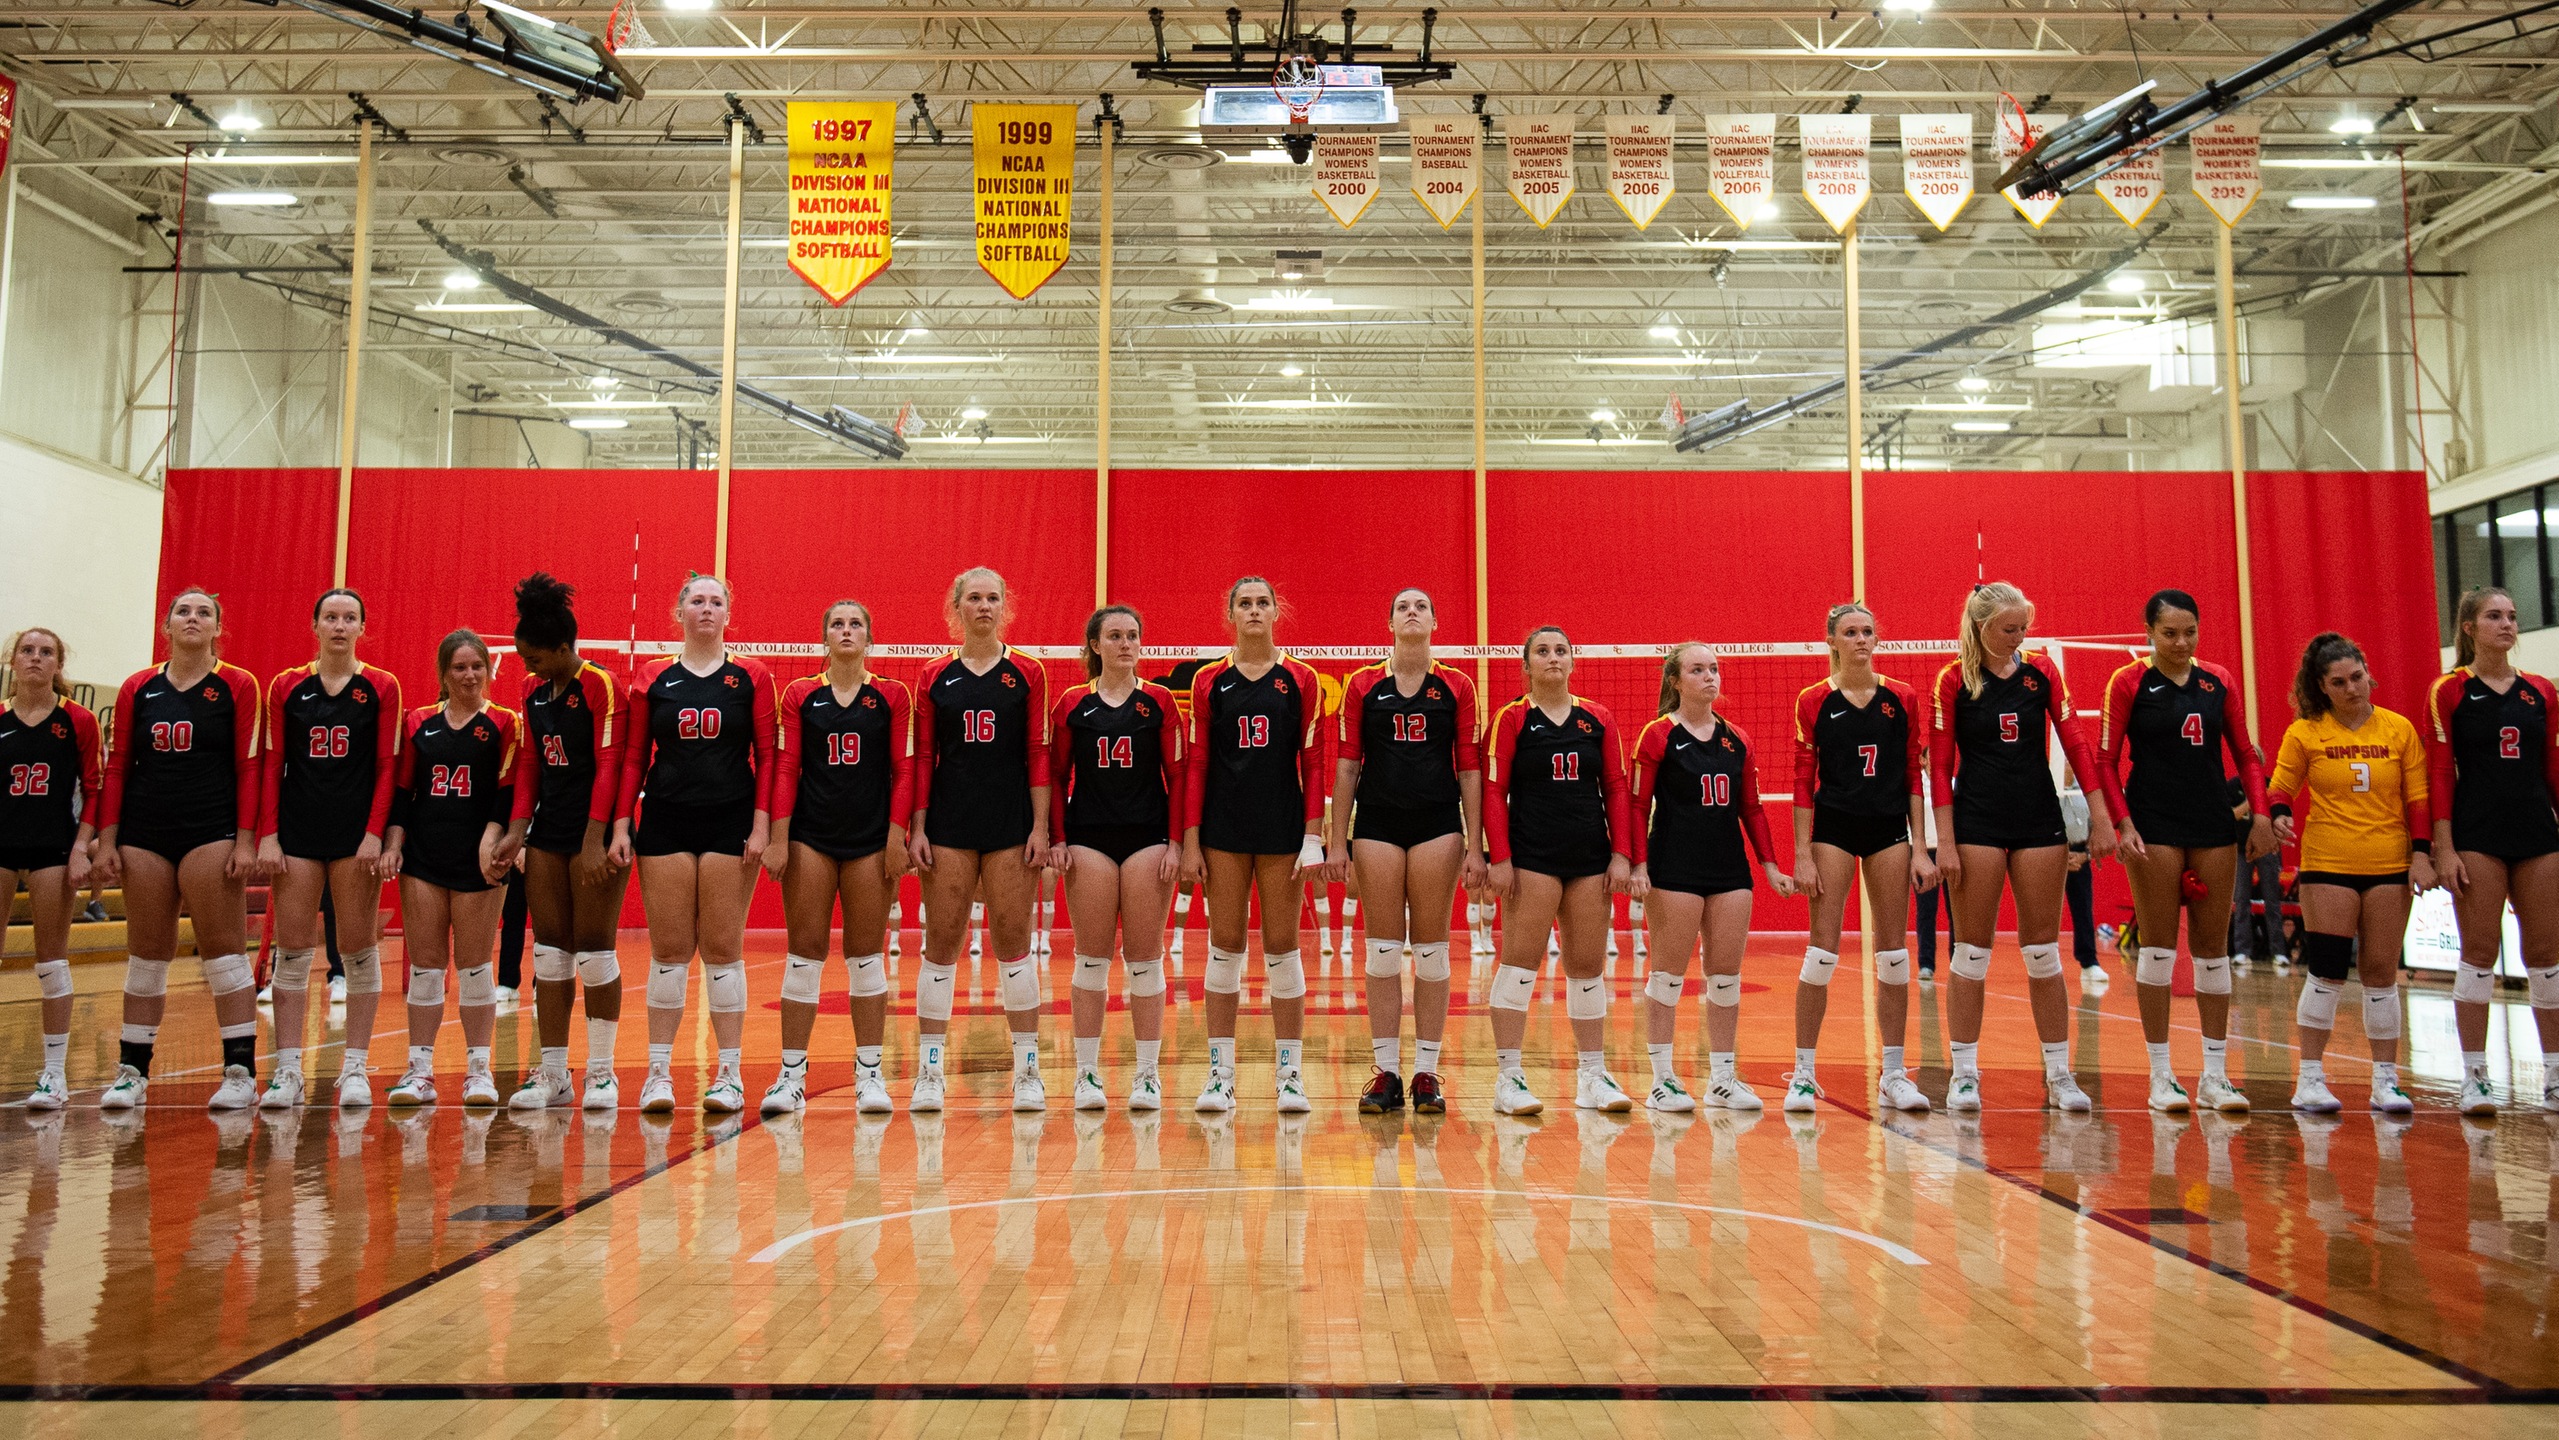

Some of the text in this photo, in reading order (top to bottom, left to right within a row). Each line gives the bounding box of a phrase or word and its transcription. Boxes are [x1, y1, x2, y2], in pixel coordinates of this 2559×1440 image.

[811, 119, 873, 142] 1997
[998, 121, 1053, 145] 1999
[1315, 135, 1378, 146] TOURNAMENT
[1412, 135, 1476, 146] TOURNAMENT
[1508, 135, 1572, 146] TOURNAMENT
[1609, 136, 1672, 146] TOURNAMENT
[1708, 135, 1773, 145] TOURNAMENT
[1905, 136, 1970, 146] TOURNAMENT
[2192, 136, 2260, 146] TOURNAMENT
[1318, 147, 1375, 157] CHAMPIONS
[1417, 147, 1472, 158] CHAMPIONS
[1512, 147, 1569, 157] CHAMPIONS
[1613, 148, 1668, 157] CHAMPIONS
[1713, 147, 1770, 157] CHAMPIONS
[1808, 148, 1864, 157] CHAMPIONS
[1909, 148, 1967, 158] CHAMPIONS
[2196, 148, 2257, 157] CHAMPIONS
[813, 152, 867, 169] NCAA
[1002, 156, 1045, 172] NCAA
[1325, 159, 1369, 169] WOMEN'S
[1421, 159, 1469, 170] BASEBALL
[1519, 158, 1563, 168] WOMEN'S
[1619, 159, 1662, 169] WOMEN'S
[1719, 158, 1764, 168] WOMEN'S
[1814, 159, 1858, 169] WOMEN'S
[1916, 159, 1961, 169] WOMEN'S
[2106, 160, 2154, 169] WMEN'S
[2203, 160, 2250, 168] WOMEN'S
[1317, 170, 1377, 181] BASKETBALL
[1512, 170, 1571, 180] BASKETBALL
[1612, 170, 1670, 181] BASKETBALL
[1713, 169, 1771, 180] VOLLEYBALL
[1806, 171, 1866, 180] BASKETBALL
[1909, 171, 1970, 181] BASKETBALL
[2195, 171, 2258, 181] BASKETBALL
[792, 173, 889, 191] DIVISION III
[977, 177, 1069, 194] DIVISION III
[1328, 183, 1367, 195] 2000
[1426, 182, 1464, 195] 2004
[1523, 182, 1560, 195] 2005
[1623, 183, 1660, 196] 2006
[1723, 182, 1762, 195] 2006
[1818, 183, 1857, 195] 2008
[1921, 183, 1959, 196] 2009
[2114, 185, 2149, 198] 2010
[798, 197, 882, 214] NATIONAL
[983, 200, 1062, 217] NATIONAL
[790, 219, 889, 236] CHAMPIONS
[975, 222, 1069, 239] CHAMPIONS
[796, 242, 882, 259] SOFTBALL
[983, 245, 1061, 262] SOFTBALL
[756, 643, 815, 654] COLLEGE
[887, 645, 945, 656] SIMPSON
[1138, 646, 1199, 657] COLLEGE
[1280, 646, 1390, 657] MPSON COLLEGE
[1463, 645, 1520, 656] SIMPSON
[1715, 643, 1775, 654] COLLEGE
[678, 707, 722, 740] 20
[963, 709, 996, 743] 16
[1393, 713, 1427, 742] 12
[1999, 712, 2019, 743] 5
[2181, 712, 2204, 746] 4
[151, 721, 194, 752] 30
[1238, 715, 1270, 748] 13
[309, 725, 350, 758] 26
[2499, 726, 2521, 759] 2
[543, 734, 570, 766] 21
[827, 732, 861, 766] 19
[1097, 736, 1133, 768] 14
[2325, 744, 2391, 761] SIMPSON
[1552, 752, 1579, 781] 11
[1858, 744, 1878, 777] 7
[9, 762, 51, 796] 32
[430, 764, 472, 797] 24
[2349, 761, 2372, 793] 3
[1700, 773, 1730, 806] 10
[2439, 931, 2460, 951] GRIL
